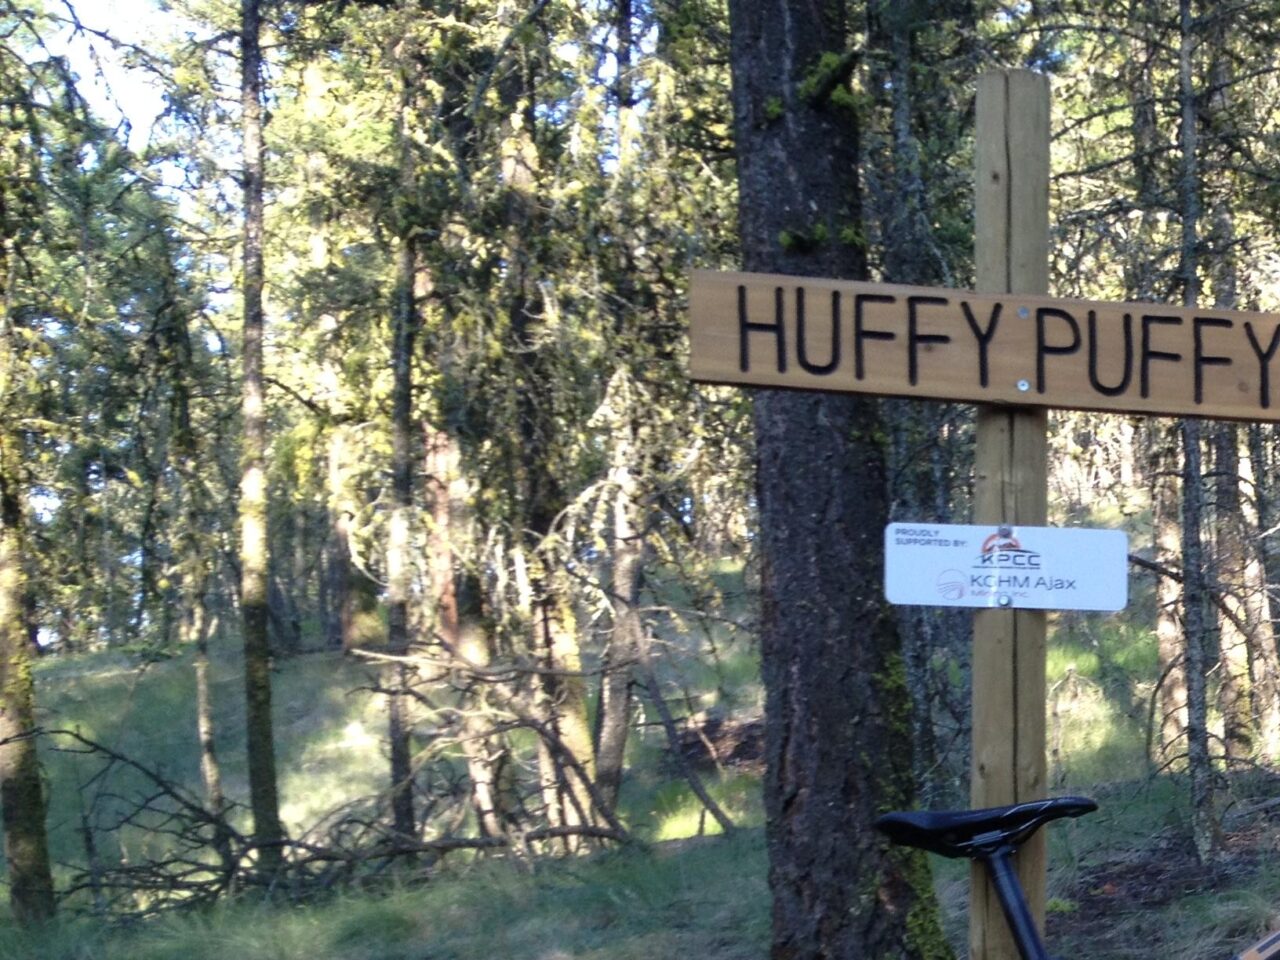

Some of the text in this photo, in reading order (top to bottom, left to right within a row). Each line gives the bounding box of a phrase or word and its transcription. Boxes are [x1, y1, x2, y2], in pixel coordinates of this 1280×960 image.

[737, 285, 1003, 389] HUFFY
[894, 528, 940, 538] PROUDLY
[894, 537, 951, 547] SUPPORTED
[980, 553, 1041, 567] KPCC
[1034, 576, 1077, 591] Ajax
